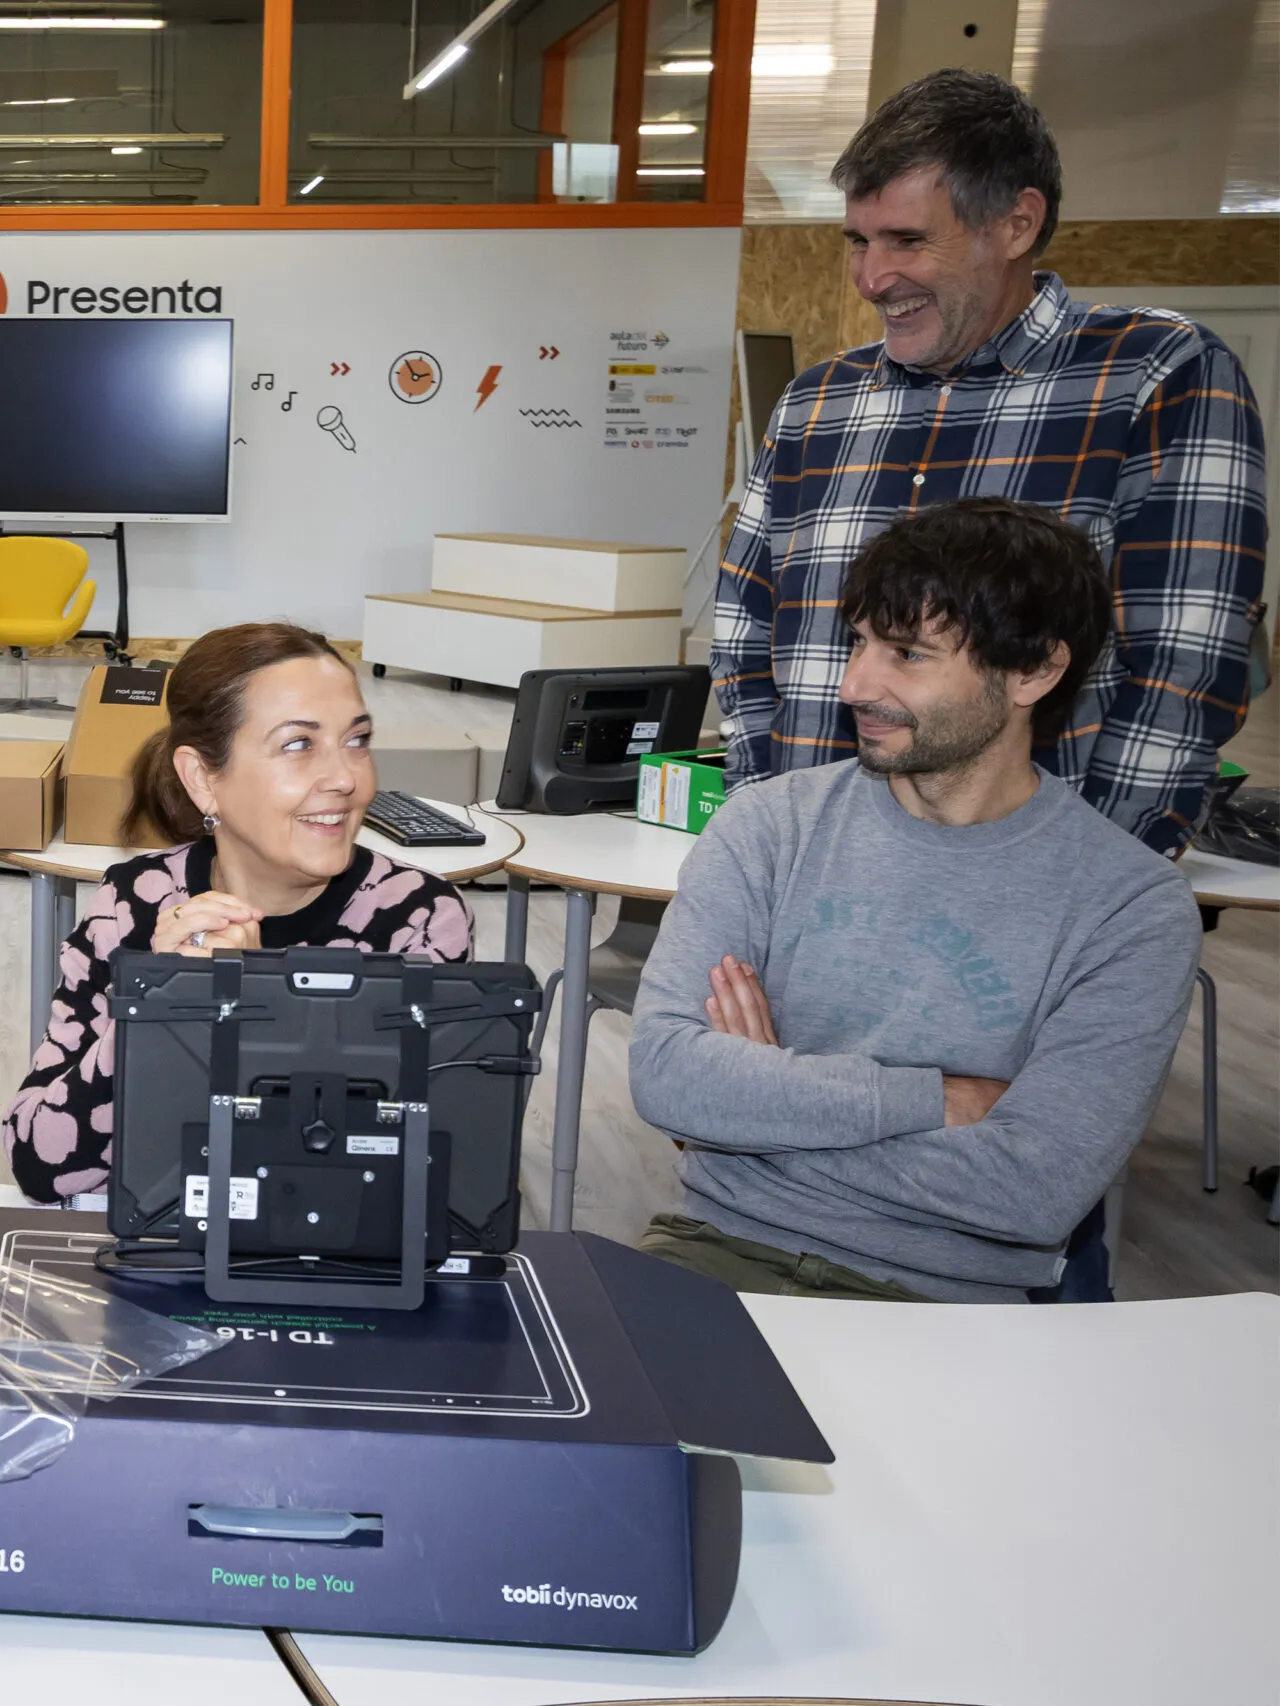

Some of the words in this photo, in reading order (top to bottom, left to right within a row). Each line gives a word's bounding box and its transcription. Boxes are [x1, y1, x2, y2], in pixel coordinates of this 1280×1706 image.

[27, 279, 222, 314] Presenta
[698, 800, 713, 813] TD
[216, 1326, 278, 1343] I-16
[288, 1330, 334, 1345] TD
[211, 1567, 266, 1588] Power
[271, 1573, 290, 1589] to
[295, 1572, 317, 1591] be
[322, 1574, 355, 1593] You
[501, 1583, 551, 1605] tobii
[552, 1586, 639, 1611] dynavox
